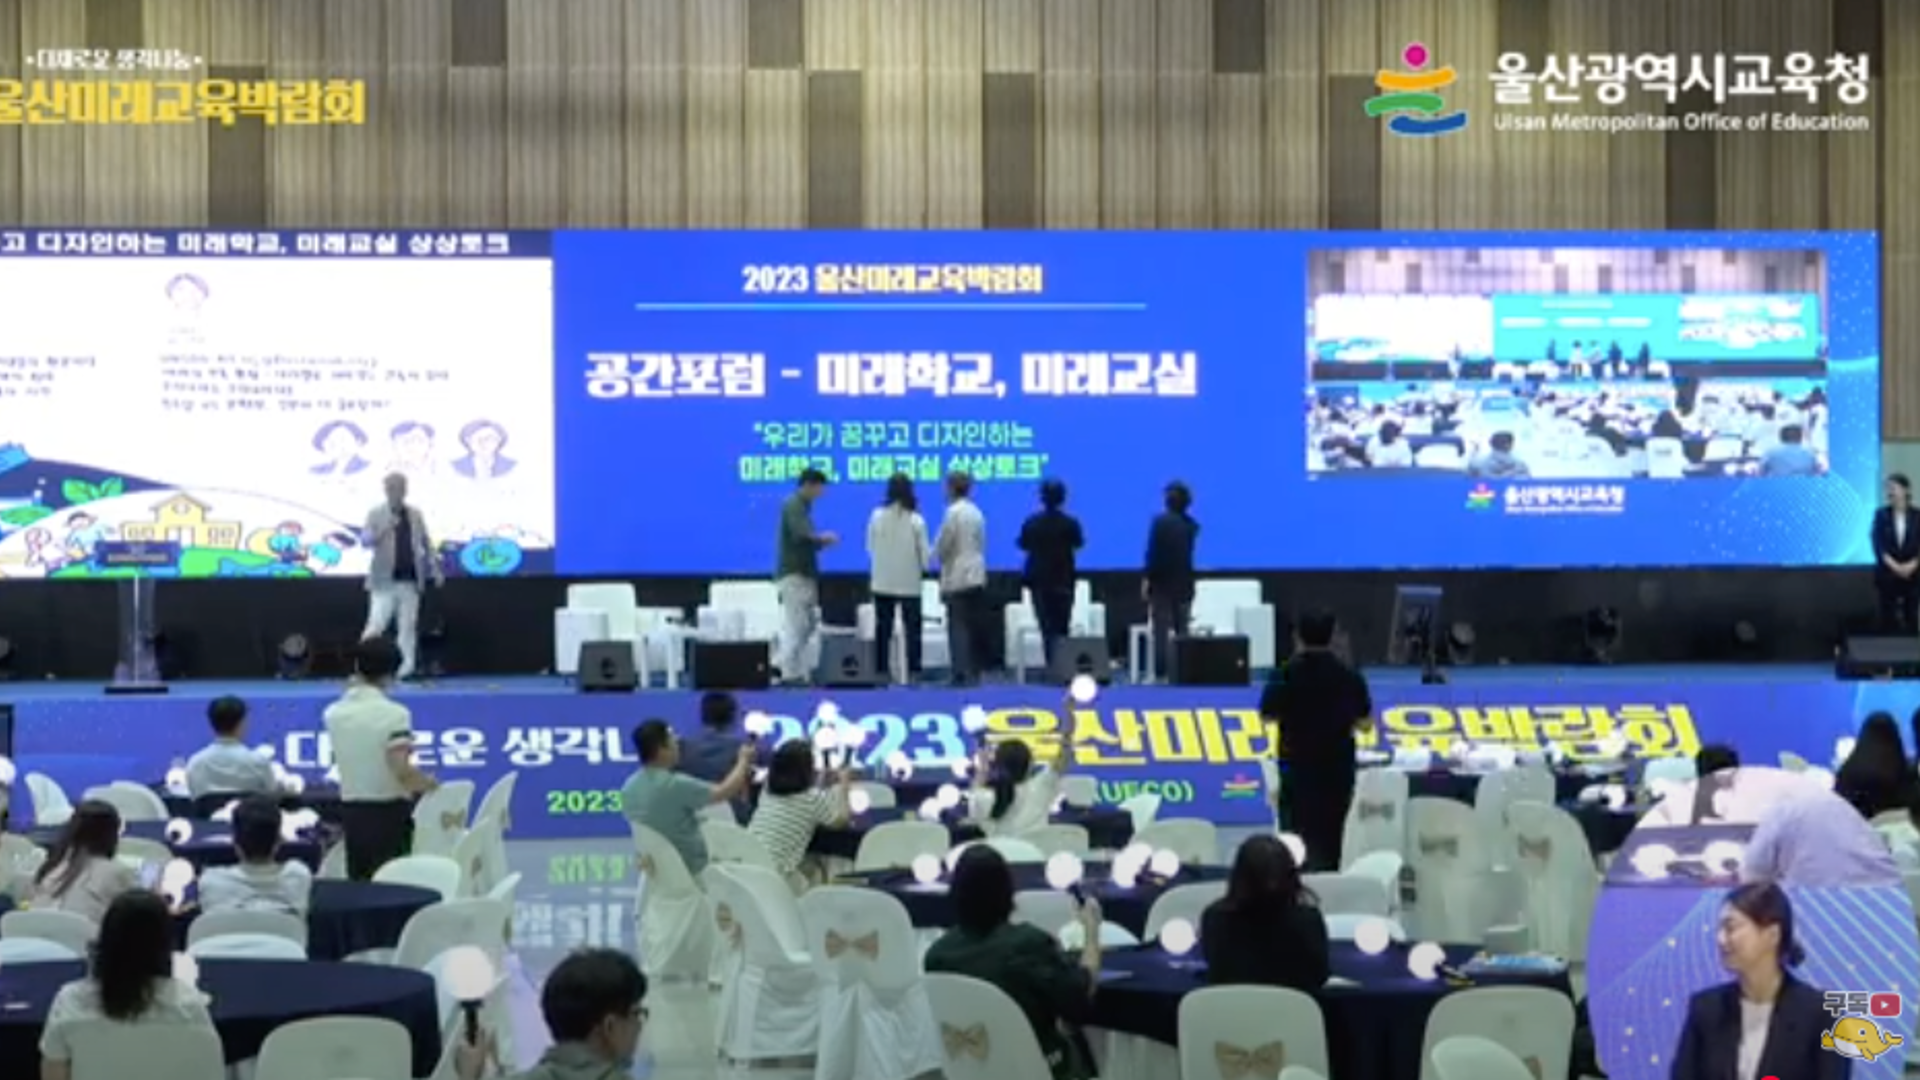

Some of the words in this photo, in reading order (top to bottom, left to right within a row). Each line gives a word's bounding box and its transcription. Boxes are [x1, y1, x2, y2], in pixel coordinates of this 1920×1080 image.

[2, 232, 26, 252] 고
[37, 232, 167, 254] 디자인하는
[408, 232, 510, 254] 상상토크
[742, 264, 808, 292] 2023
[815, 262, 1043, 294] 울산미래교육박람회
[585, 351, 766, 398] 공간포럼
[816, 351, 1007, 399] 미래학교,
[1021, 351, 1198, 397] 미래교실
[841, 421, 910, 448] 꿈꾸고
[917, 421, 1034, 448] 디자인하는
[284, 728, 488, 769] 다로운
[546, 790, 624, 814] 2023
